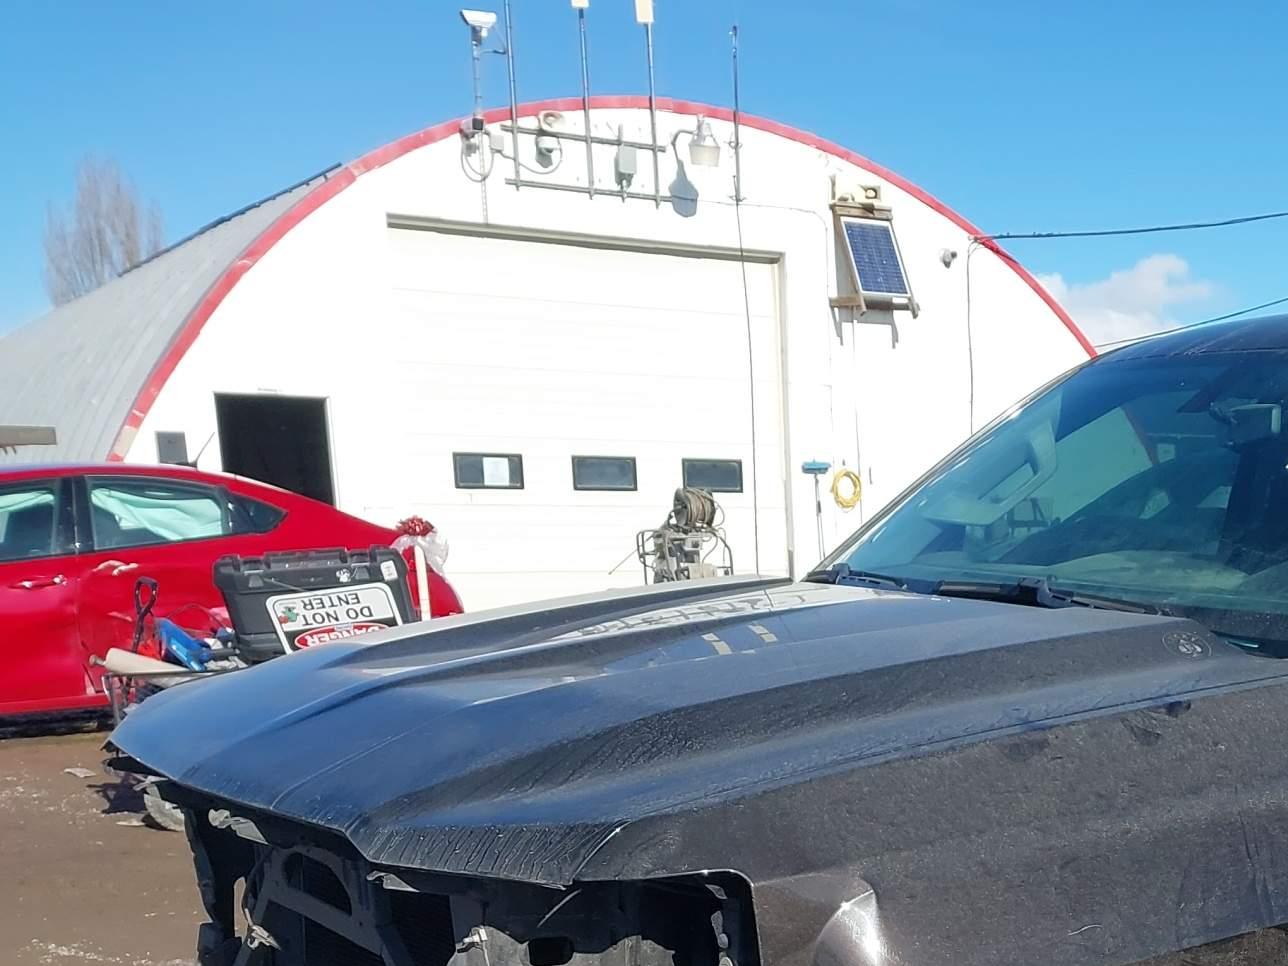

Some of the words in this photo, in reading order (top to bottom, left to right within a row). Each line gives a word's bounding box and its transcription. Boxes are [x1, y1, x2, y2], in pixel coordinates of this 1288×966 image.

[301, 592, 361, 611] ENTER
[302, 609, 340, 626] NOT
[346, 605, 374, 620] DO
